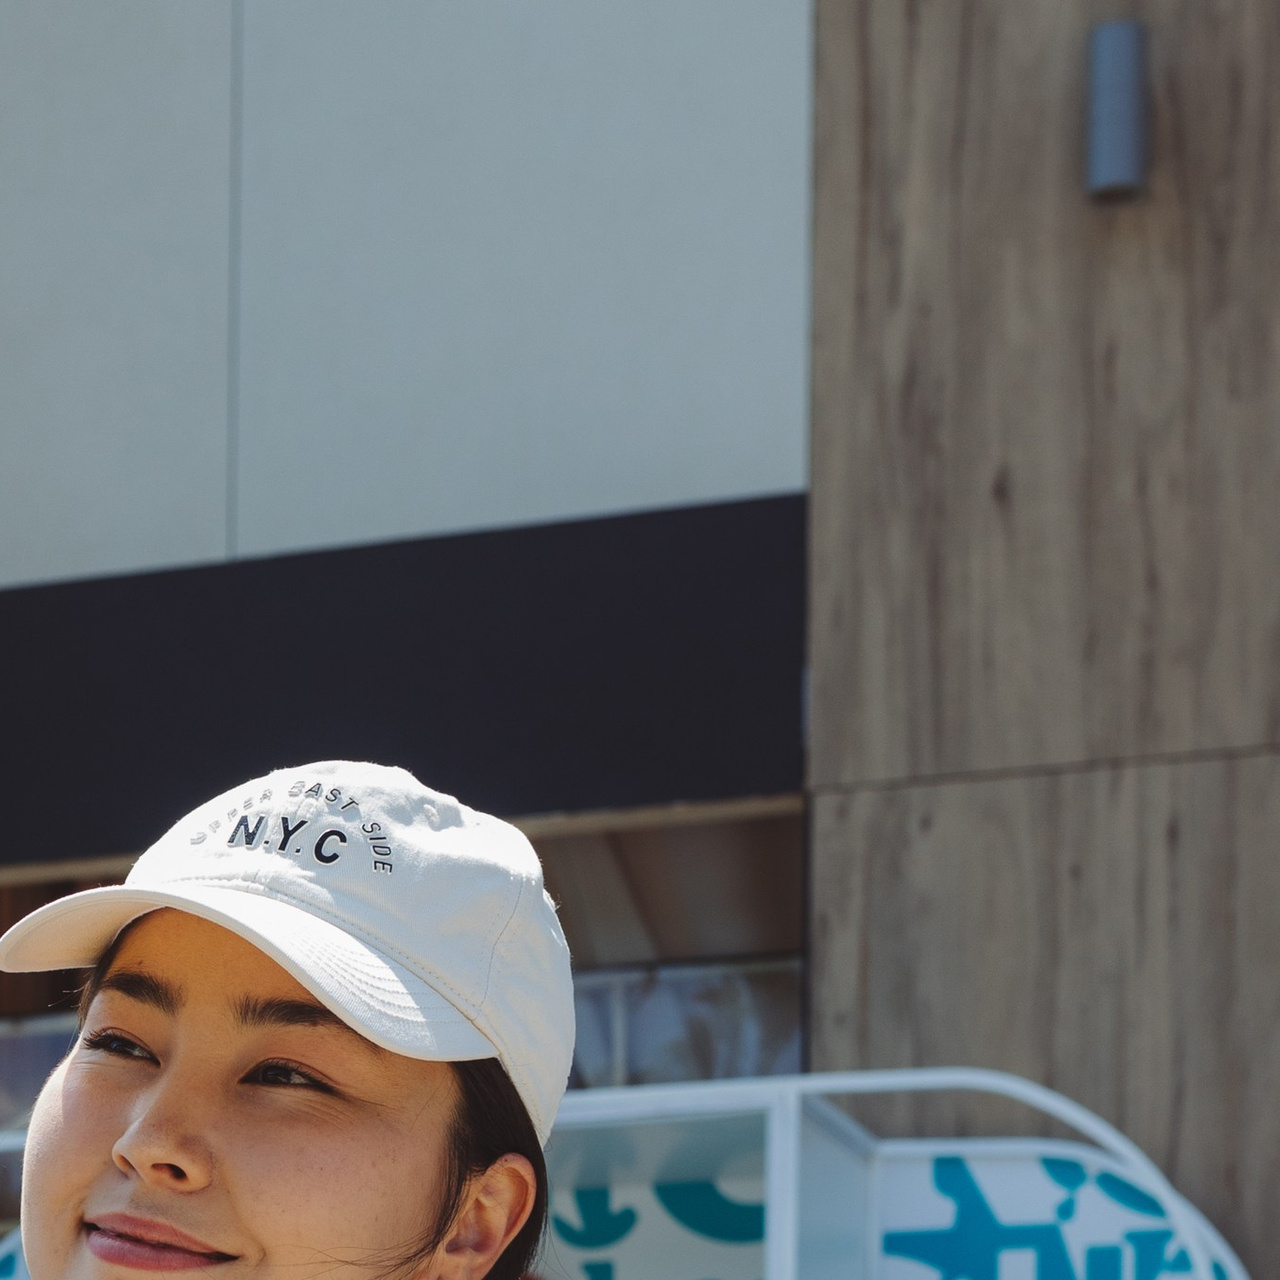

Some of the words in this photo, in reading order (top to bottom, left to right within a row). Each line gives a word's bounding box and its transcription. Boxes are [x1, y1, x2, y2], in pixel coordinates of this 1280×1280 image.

[227, 814, 348, 864] N.Y.C
[288, 780, 360, 811] EAST
[361, 821, 393, 874] SIDE
